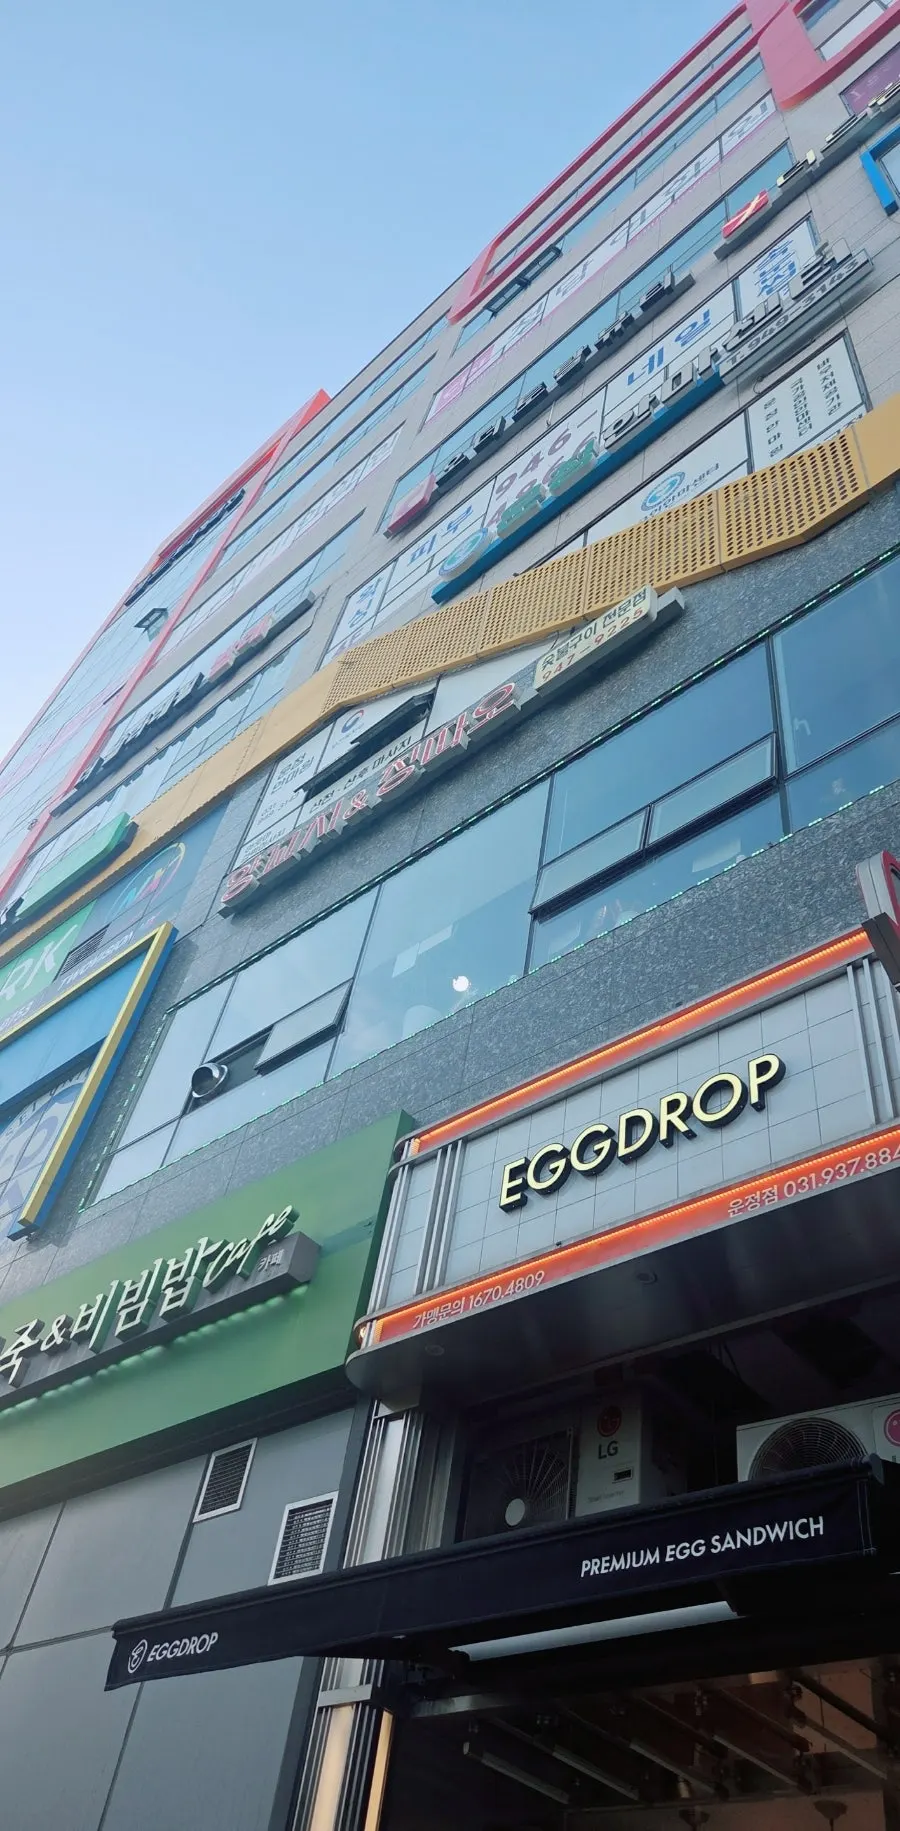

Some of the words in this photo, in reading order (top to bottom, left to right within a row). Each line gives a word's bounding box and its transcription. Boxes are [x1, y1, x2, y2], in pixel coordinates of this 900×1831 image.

[627, 308, 712, 386] 네일
[407, 504, 474, 566] 피부
[540, 621, 598, 672] 숯불구이
[602, 590, 649, 629] 전문점
[372, 734, 413, 770] 마사지
[499, 1052, 784, 1211] EGGDROP
[728, 1184, 778, 1218] 운정점
[258, 1249, 285, 1273] 카페
[412, 1297, 466, 1330] 가맹문의
[469, 1269, 546, 1311] 1670.4809
[597, 1440, 619, 1461] LG
[580, 1545, 660, 1579] PREMIUM
[665, 1539, 706, 1563] EGG
[710, 1515, 825, 1555] SANDWICH
[147, 1631, 219, 1664] EGGDROP
